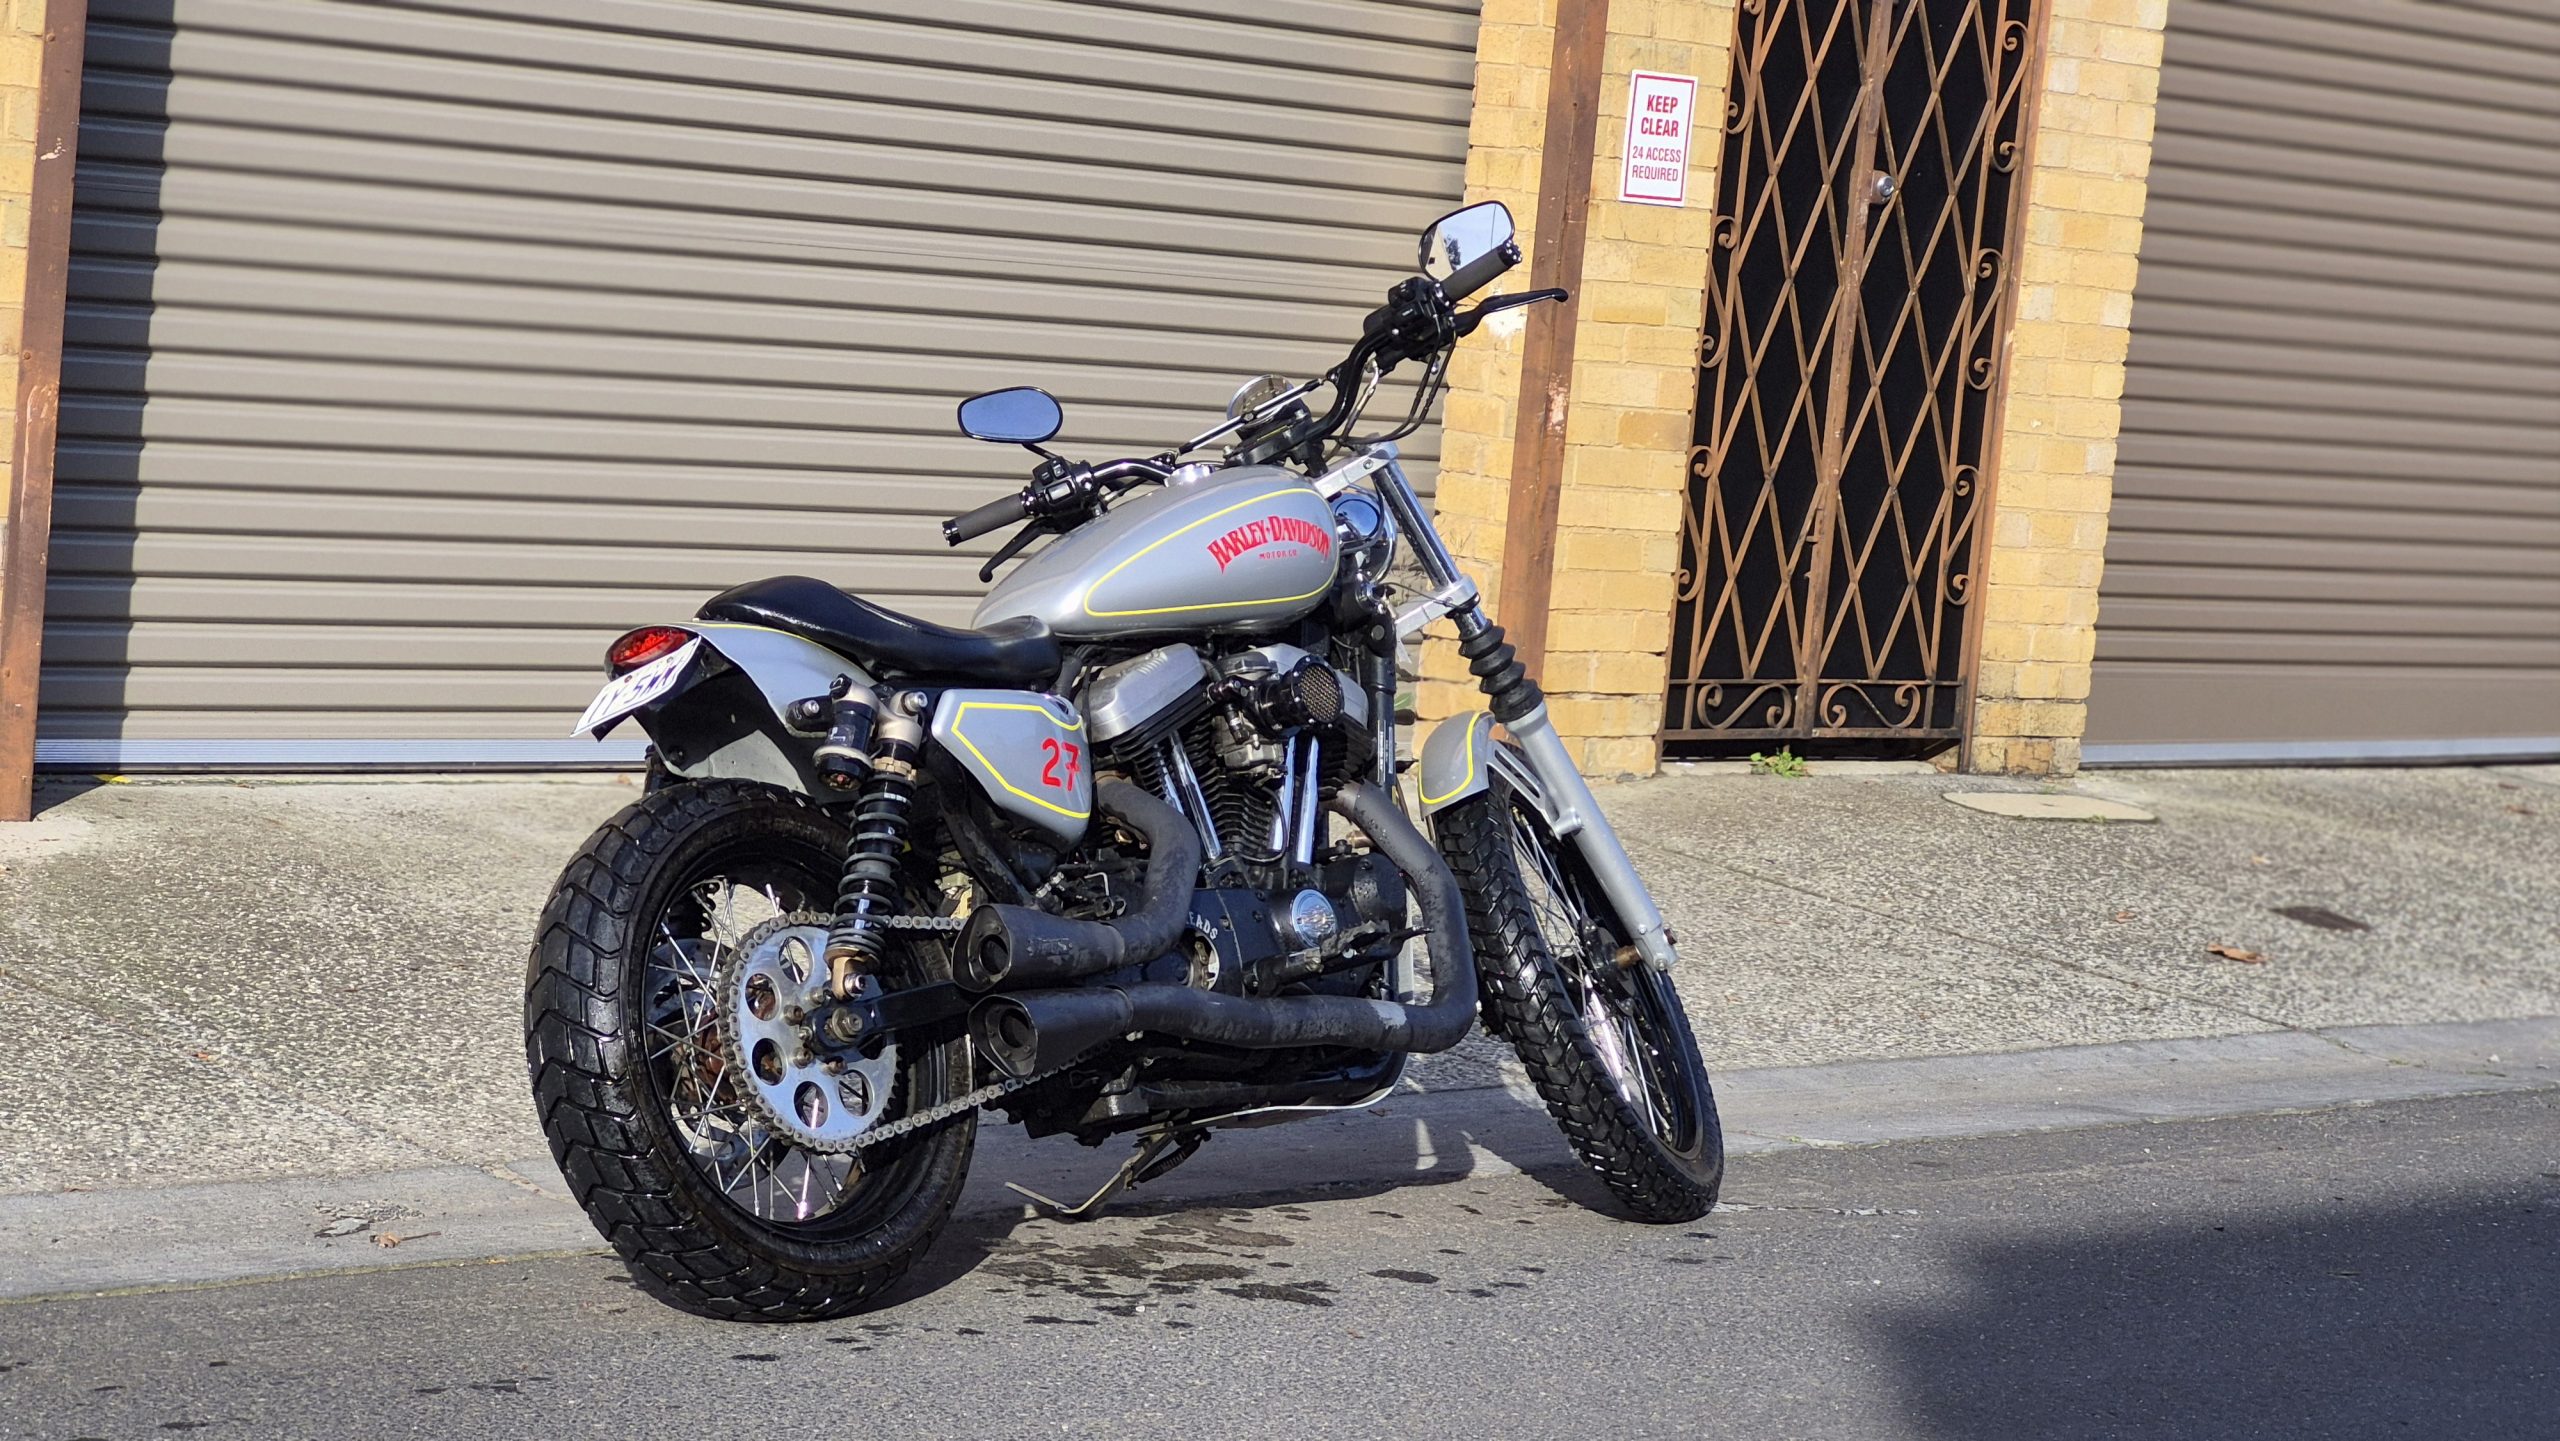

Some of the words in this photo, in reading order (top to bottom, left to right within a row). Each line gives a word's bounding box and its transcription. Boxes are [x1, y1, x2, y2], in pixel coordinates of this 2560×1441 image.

[1647, 94, 1679, 114] KEEP
[1641, 117, 1679, 138] CLEAR
[1632, 145, 1644, 159] 24
[1646, 147, 1682, 163] ACCESS
[1632, 165, 1679, 182] REQUIRED
[1041, 738, 1081, 792] 27
[1185, 911, 1219, 940] EADS
